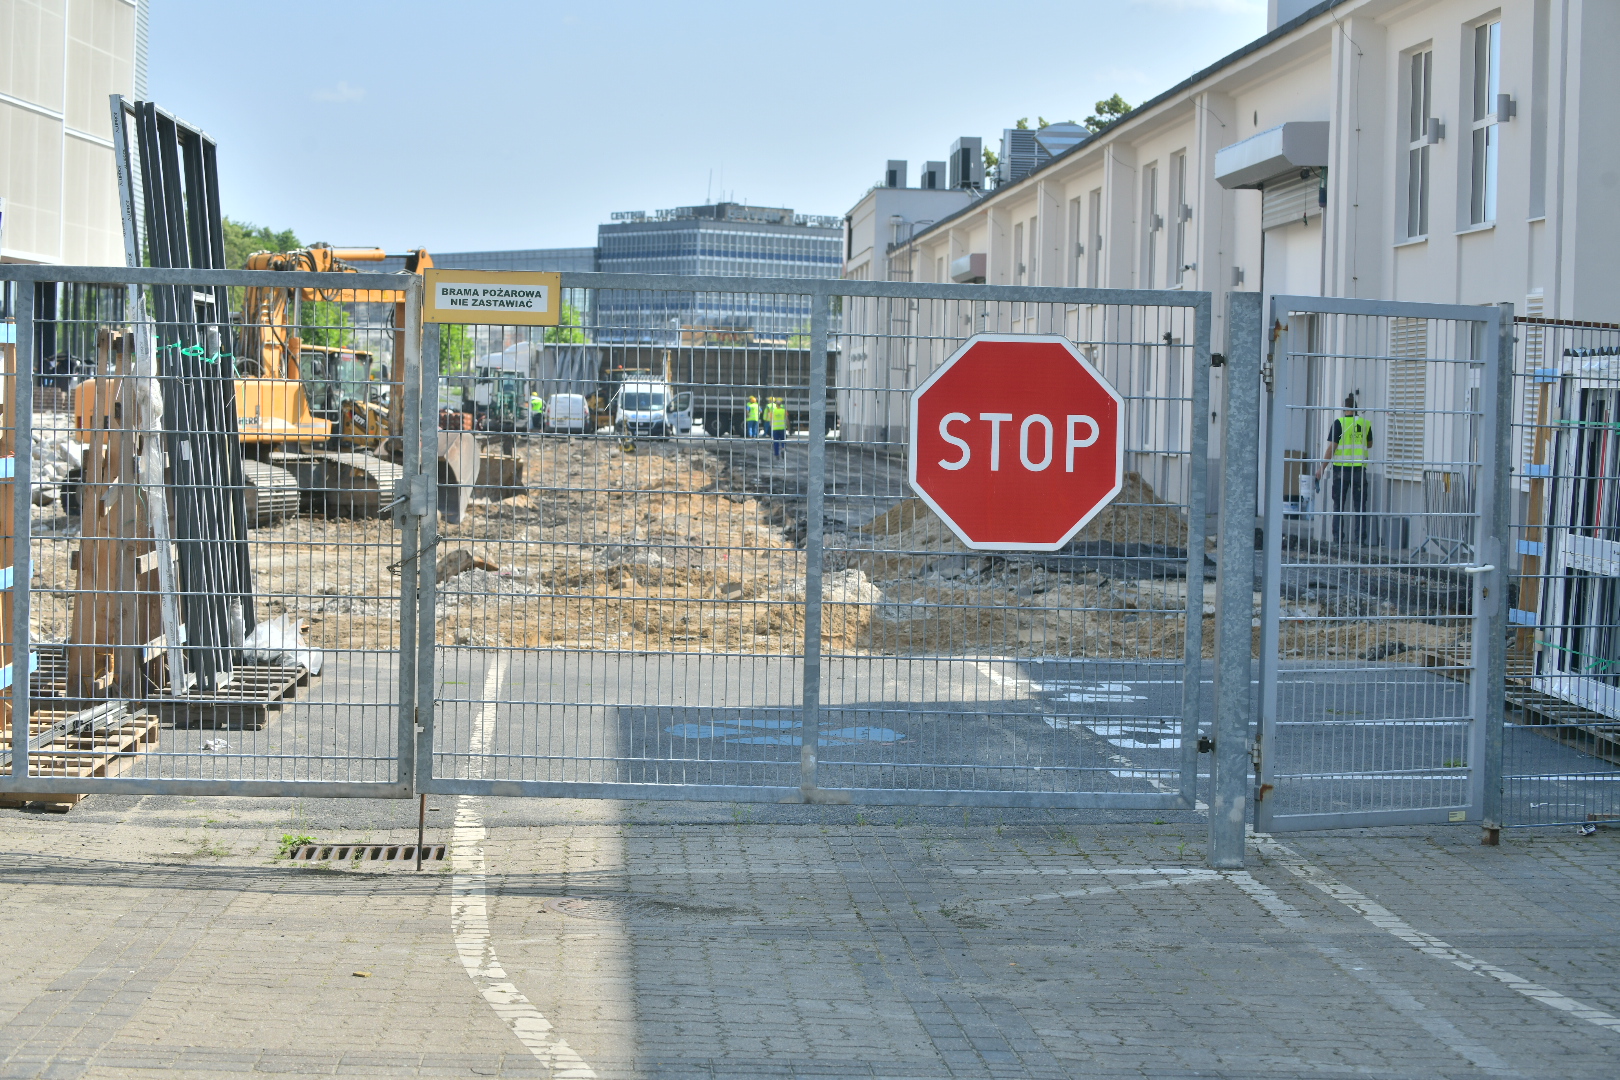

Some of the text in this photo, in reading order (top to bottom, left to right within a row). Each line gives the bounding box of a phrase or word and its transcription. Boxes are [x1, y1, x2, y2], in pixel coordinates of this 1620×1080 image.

[441, 287, 542, 299] BRAMA POŻAROWA
[450, 298, 533, 308] NIE ZASTAWIAĆ
[937, 411, 1100, 473] STOP
